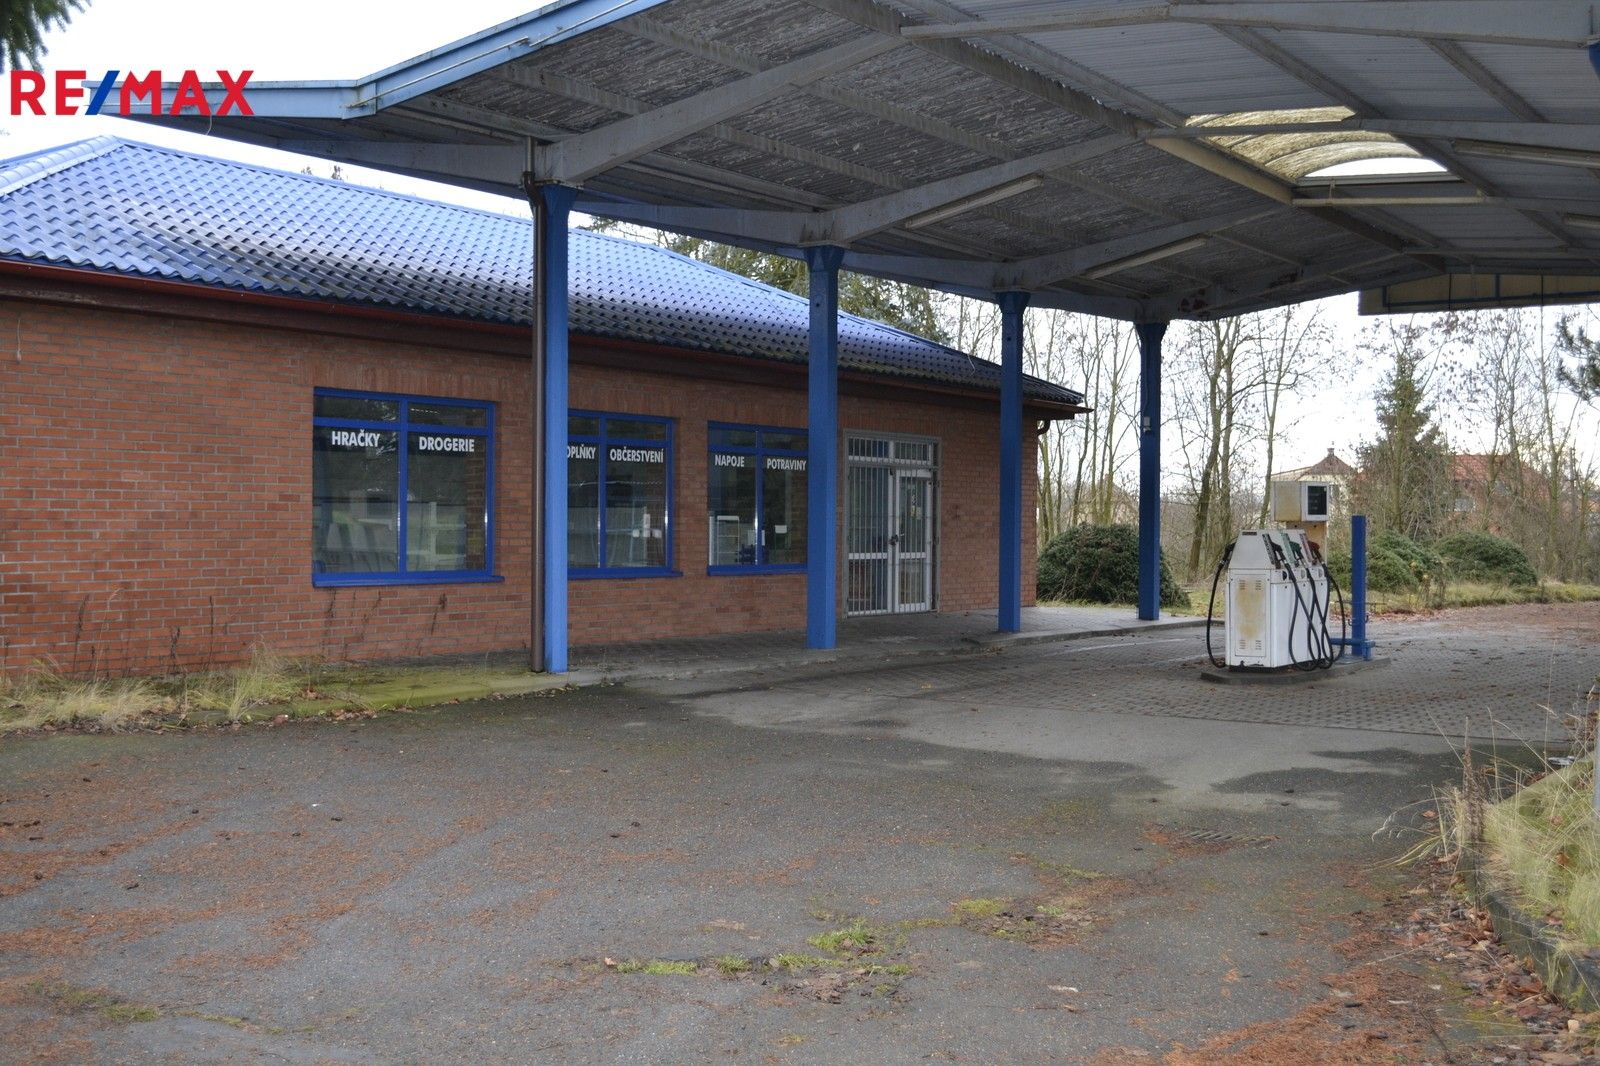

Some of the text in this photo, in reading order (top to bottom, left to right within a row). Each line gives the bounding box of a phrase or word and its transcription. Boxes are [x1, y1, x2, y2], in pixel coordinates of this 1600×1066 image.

[331, 429, 380, 447] HRAČKY
[419, 436, 475, 452] DROGERIE
[610, 446, 664, 463] OBČERSTVENÍ
[715, 454, 745, 468] NAPOJE
[766, 458, 807, 471] POTRAVINY
